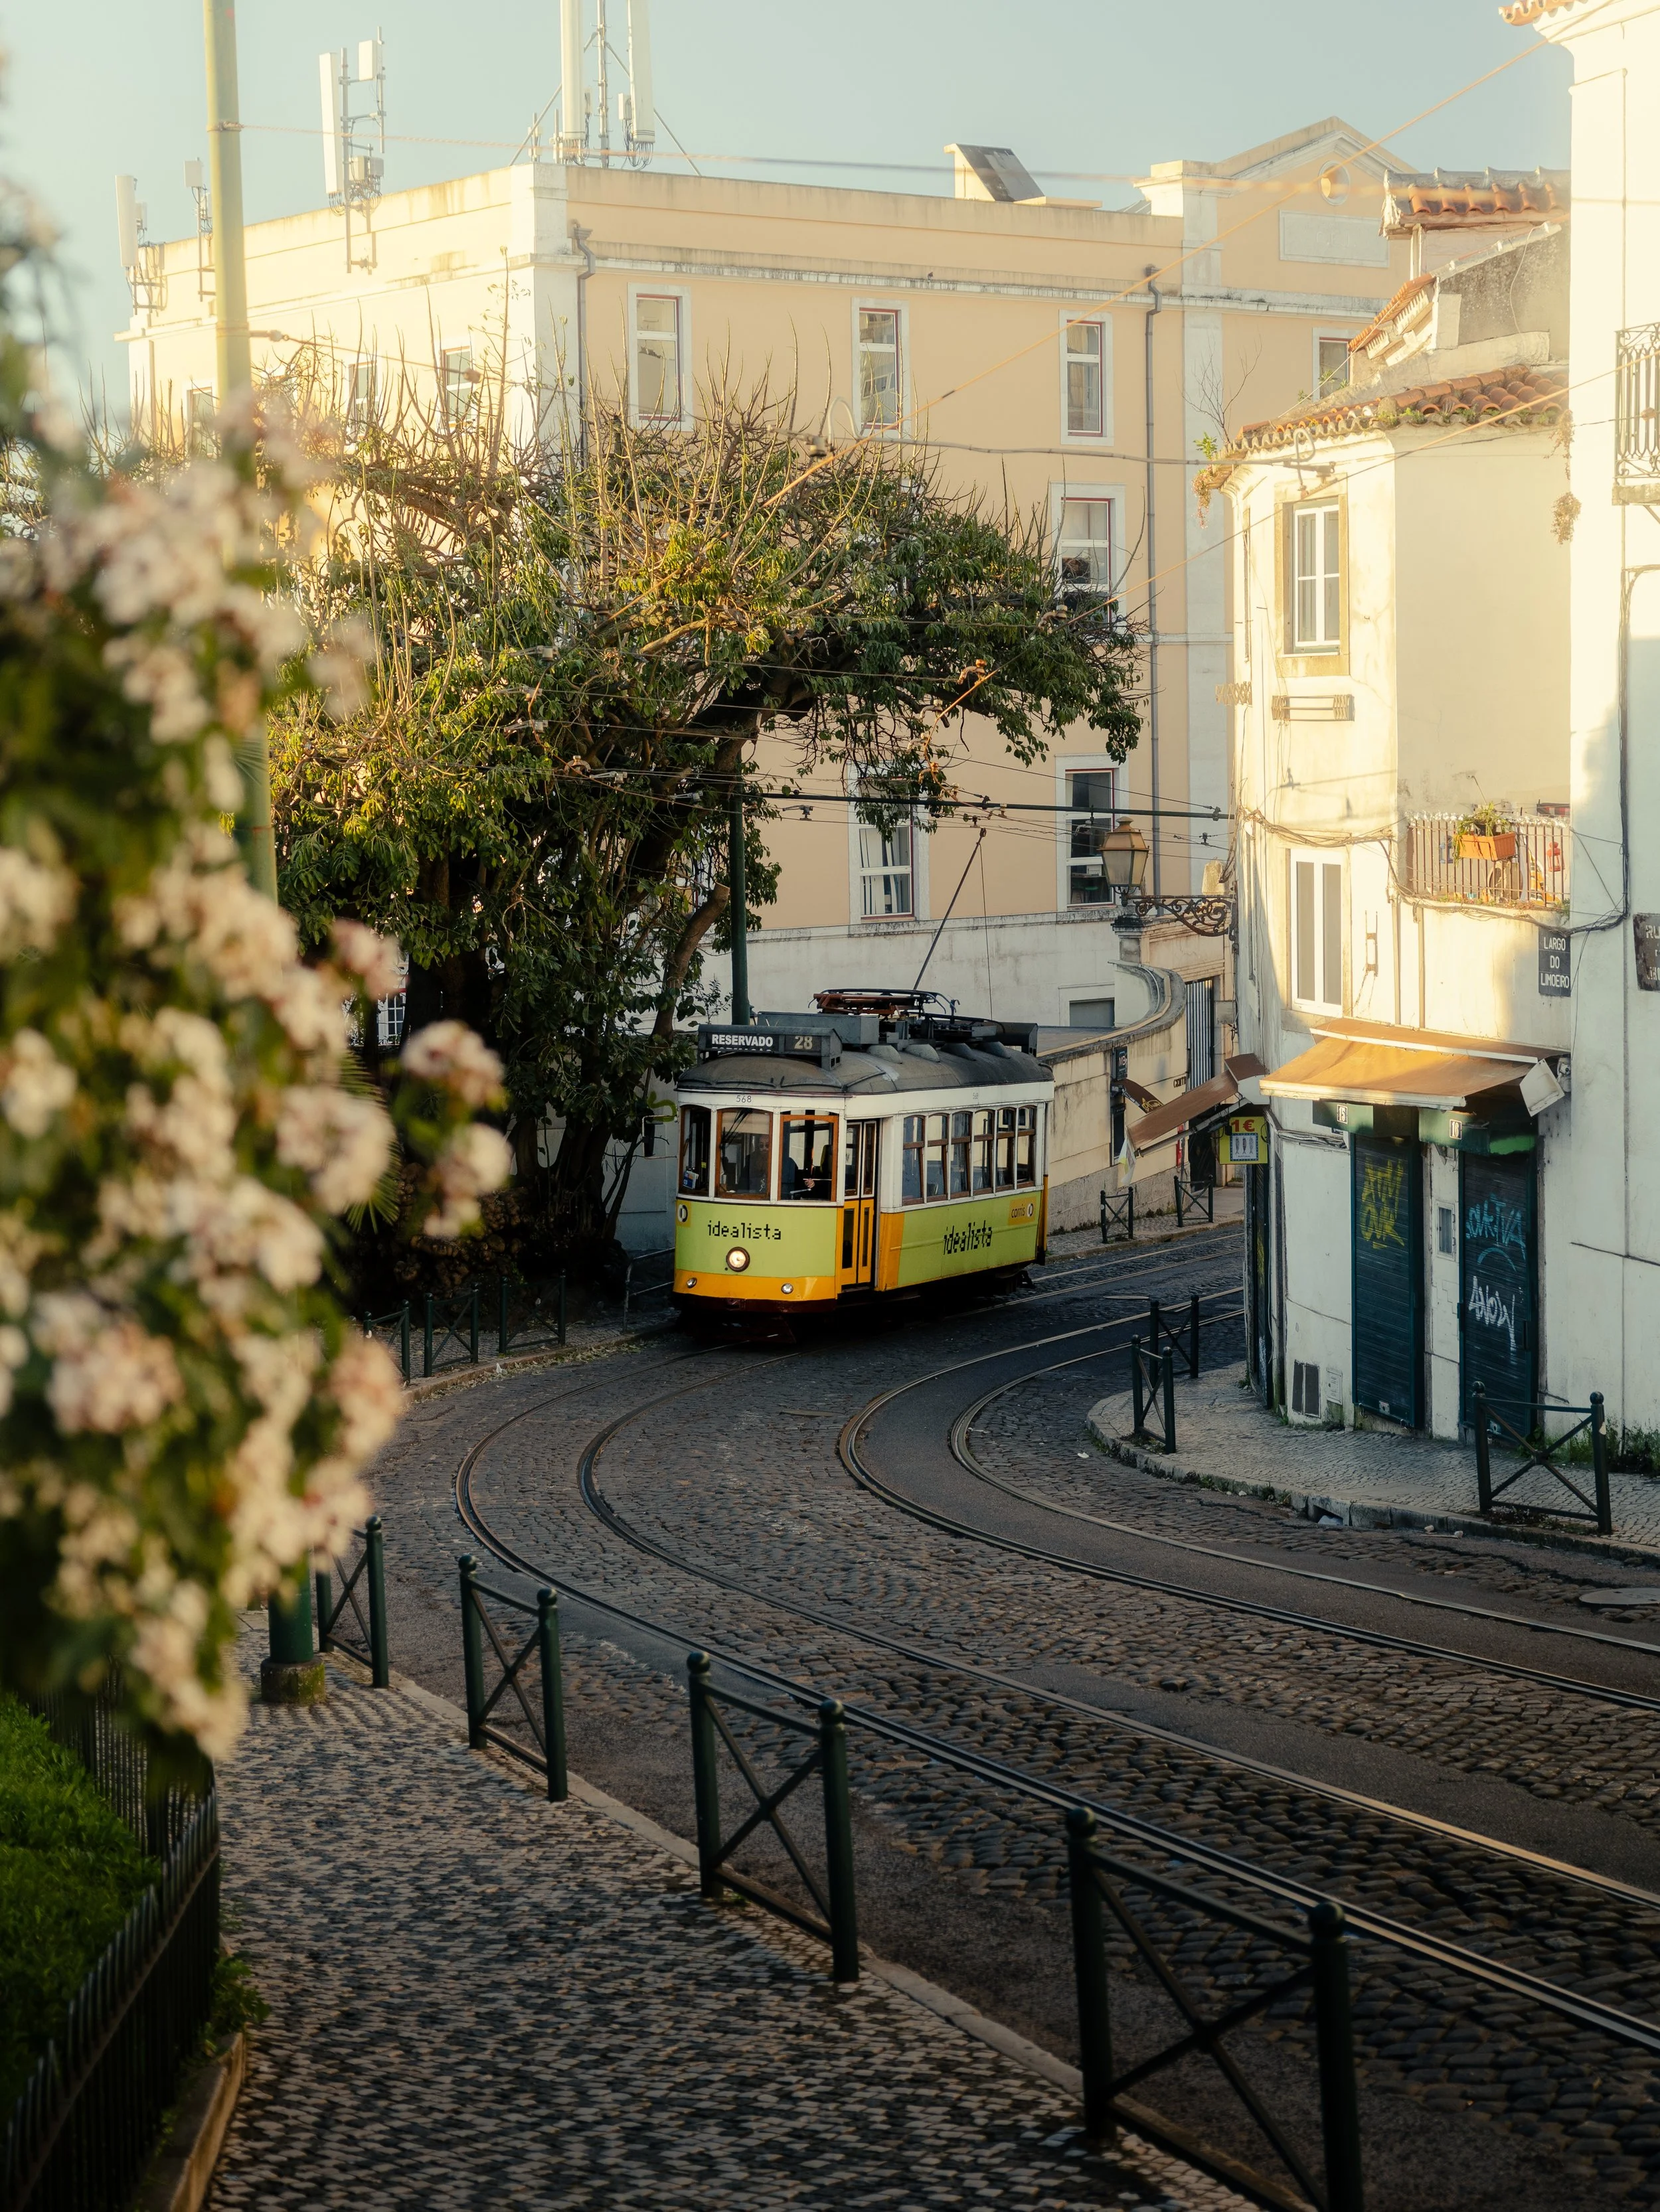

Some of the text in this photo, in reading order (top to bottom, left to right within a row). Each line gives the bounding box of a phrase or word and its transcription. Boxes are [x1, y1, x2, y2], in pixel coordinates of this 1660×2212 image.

[1646, 925, 1660, 939] RU
[1544, 937, 1566, 951] LARGO
[1550, 955, 1560, 969] DO
[1540, 973, 1570, 988] LIMOEIRO
[712, 1034, 774, 1047] RESERVADO
[794, 1036, 813, 1050] 28
[1339, 1107, 1346, 1121] 15
[1011, 1204, 1025, 1218] carris
[708, 1220, 781, 1240] idealista
[944, 1220, 992, 1255] idealista
